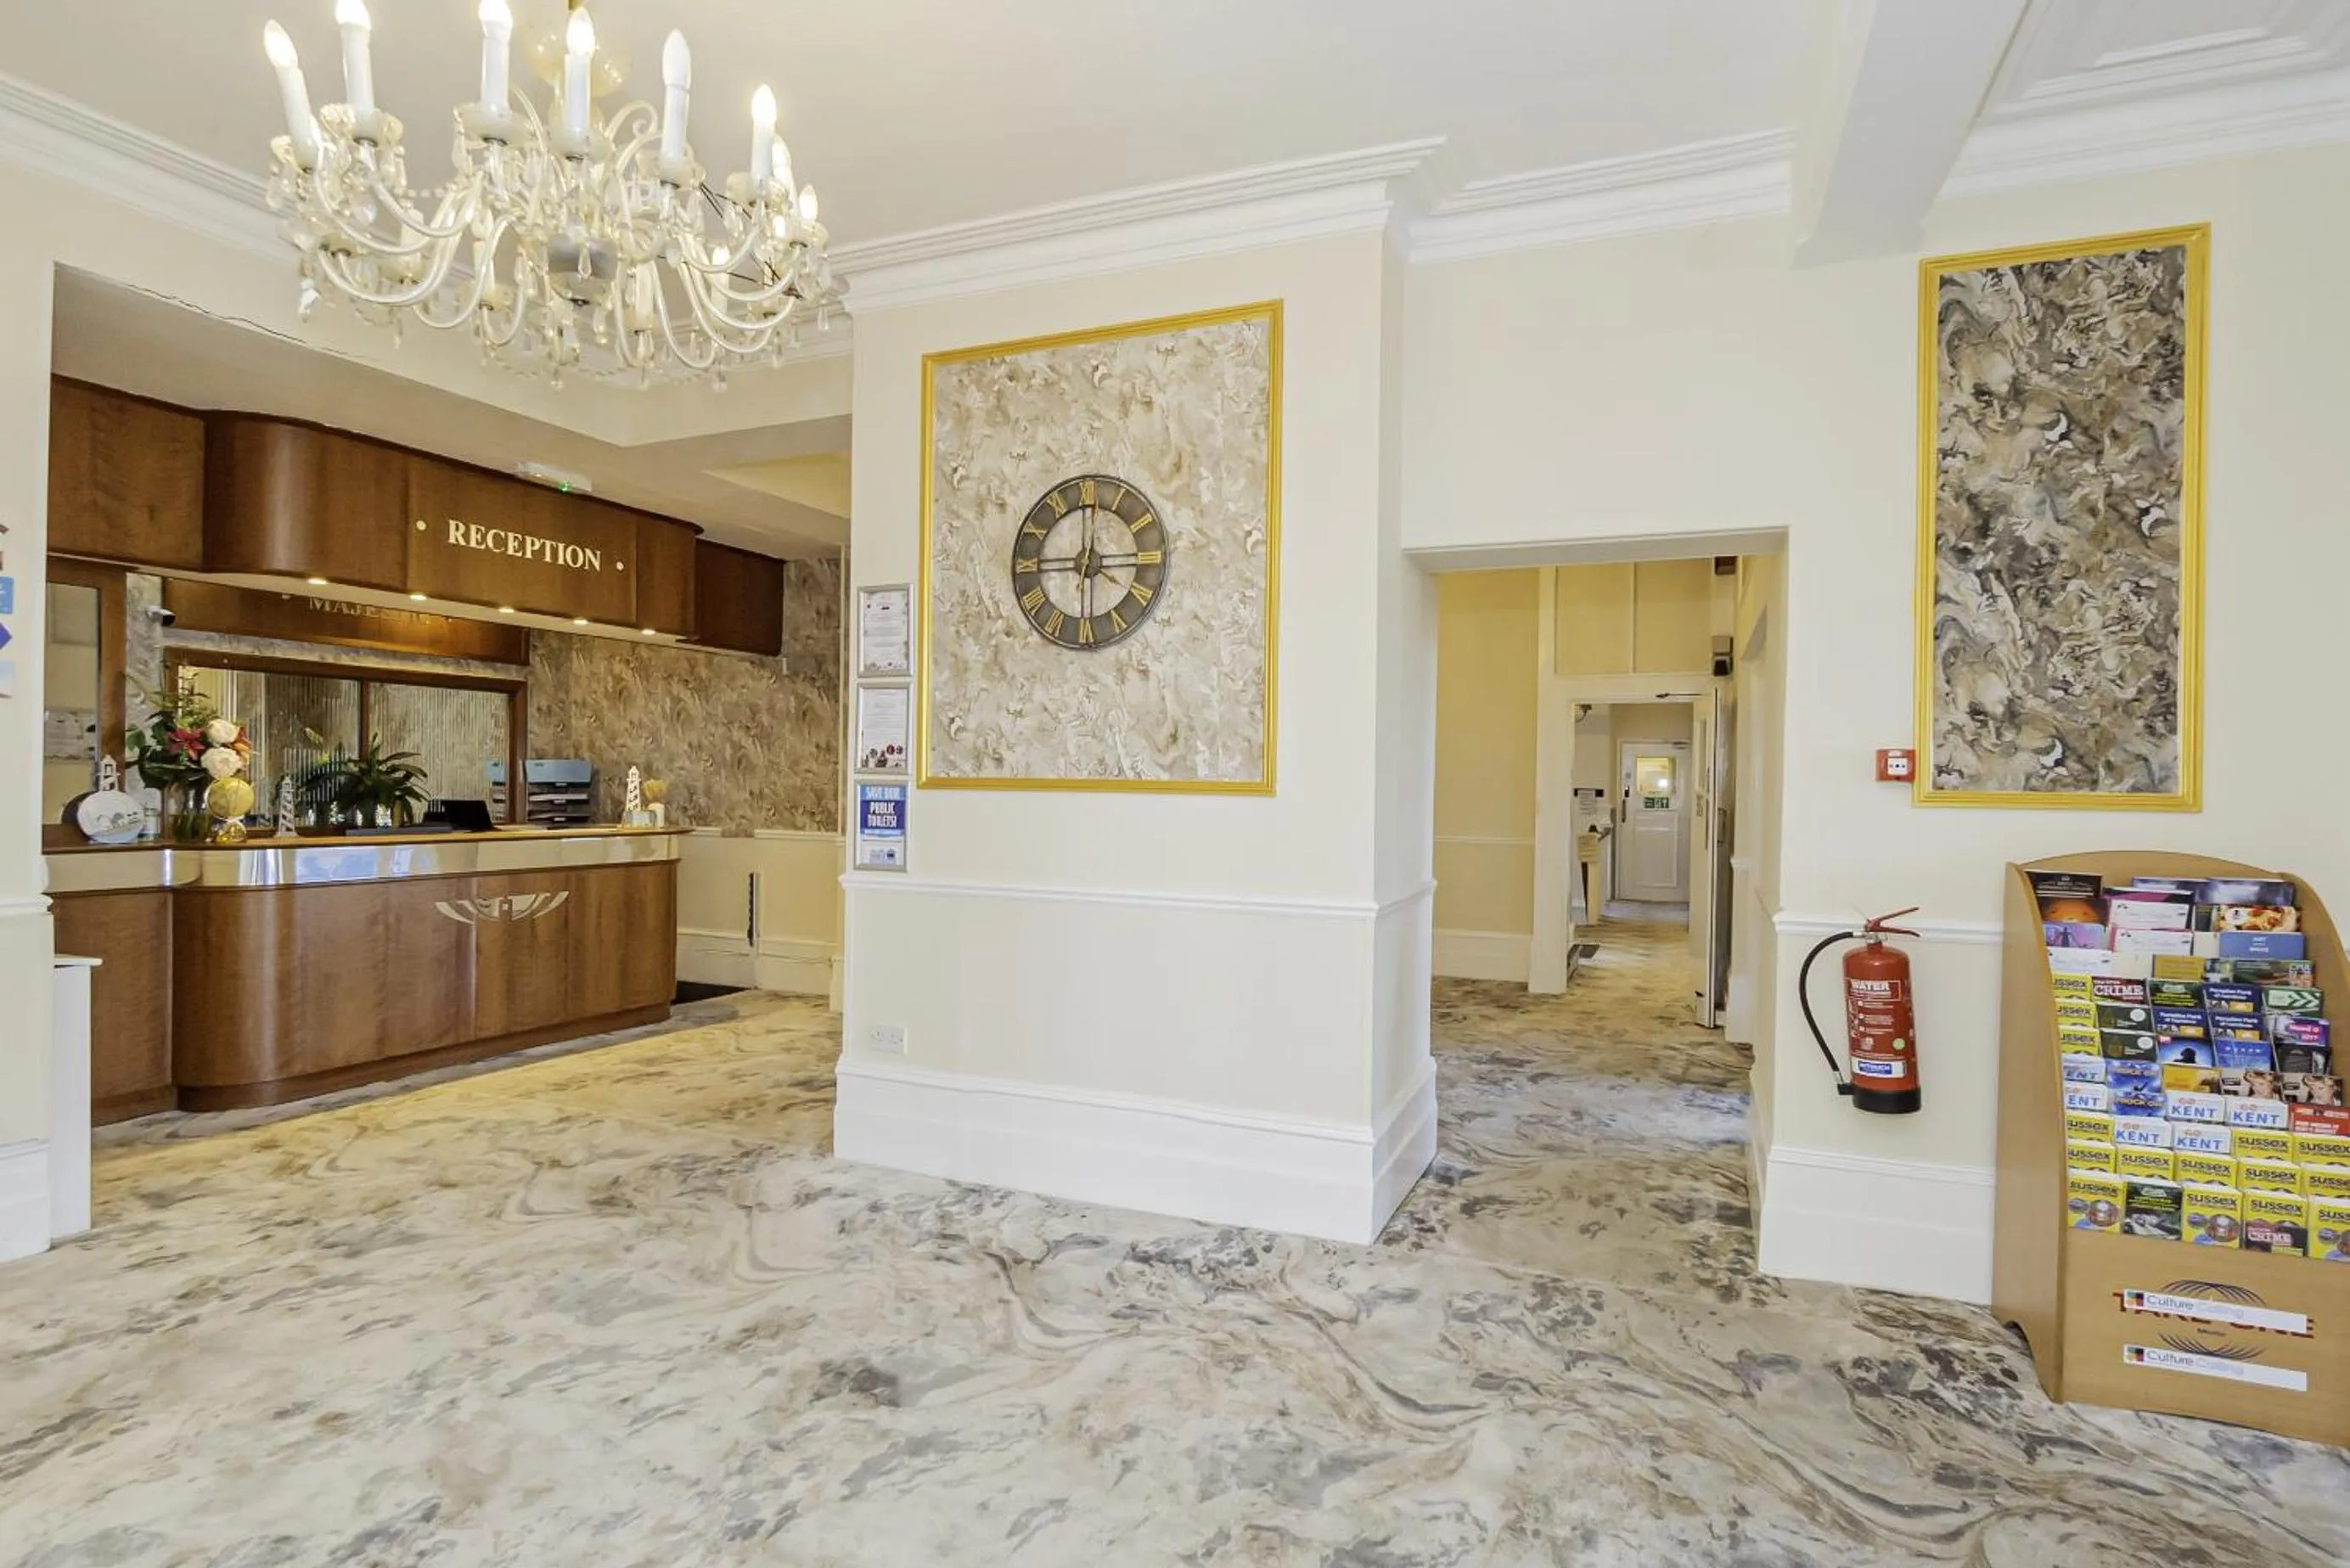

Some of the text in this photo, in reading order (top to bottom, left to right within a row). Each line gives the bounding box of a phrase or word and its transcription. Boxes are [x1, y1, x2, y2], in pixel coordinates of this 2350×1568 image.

[1079, 480, 1094, 507] XII
[1112, 488, 1127, 511] I
[1047, 492, 1068, 519] XI
[1023, 522, 1047, 540] X
[1130, 513, 1154, 533] II
[447, 519, 601, 571] RECEPTION
[1016, 557, 1038, 574] IX
[1137, 551, 1162, 564] III
[1022, 586, 1047, 616] VIII
[1043, 610, 1065, 637] VII
[1110, 610, 1127, 633] V
[1079, 618, 1094, 643] VI
[866, 787, 901, 801] SAVE OUR
[869, 801, 895, 814] PUBLIC
[1851, 981, 1890, 992] WATER
[2094, 984, 2145, 996] CRIME
[2066, 1069, 2098, 1080] ENT
[2067, 1094, 2100, 1106] ENT
[2171, 1104, 2218, 1119] KENT
[2234, 1111, 2280, 1124] KENT
[2116, 1129, 2160, 1144] KENT
[2176, 1138, 2223, 1150] KENT
[2146, 1294, 2195, 1311] Culture
[2146, 1350, 2195, 1367] Culture
